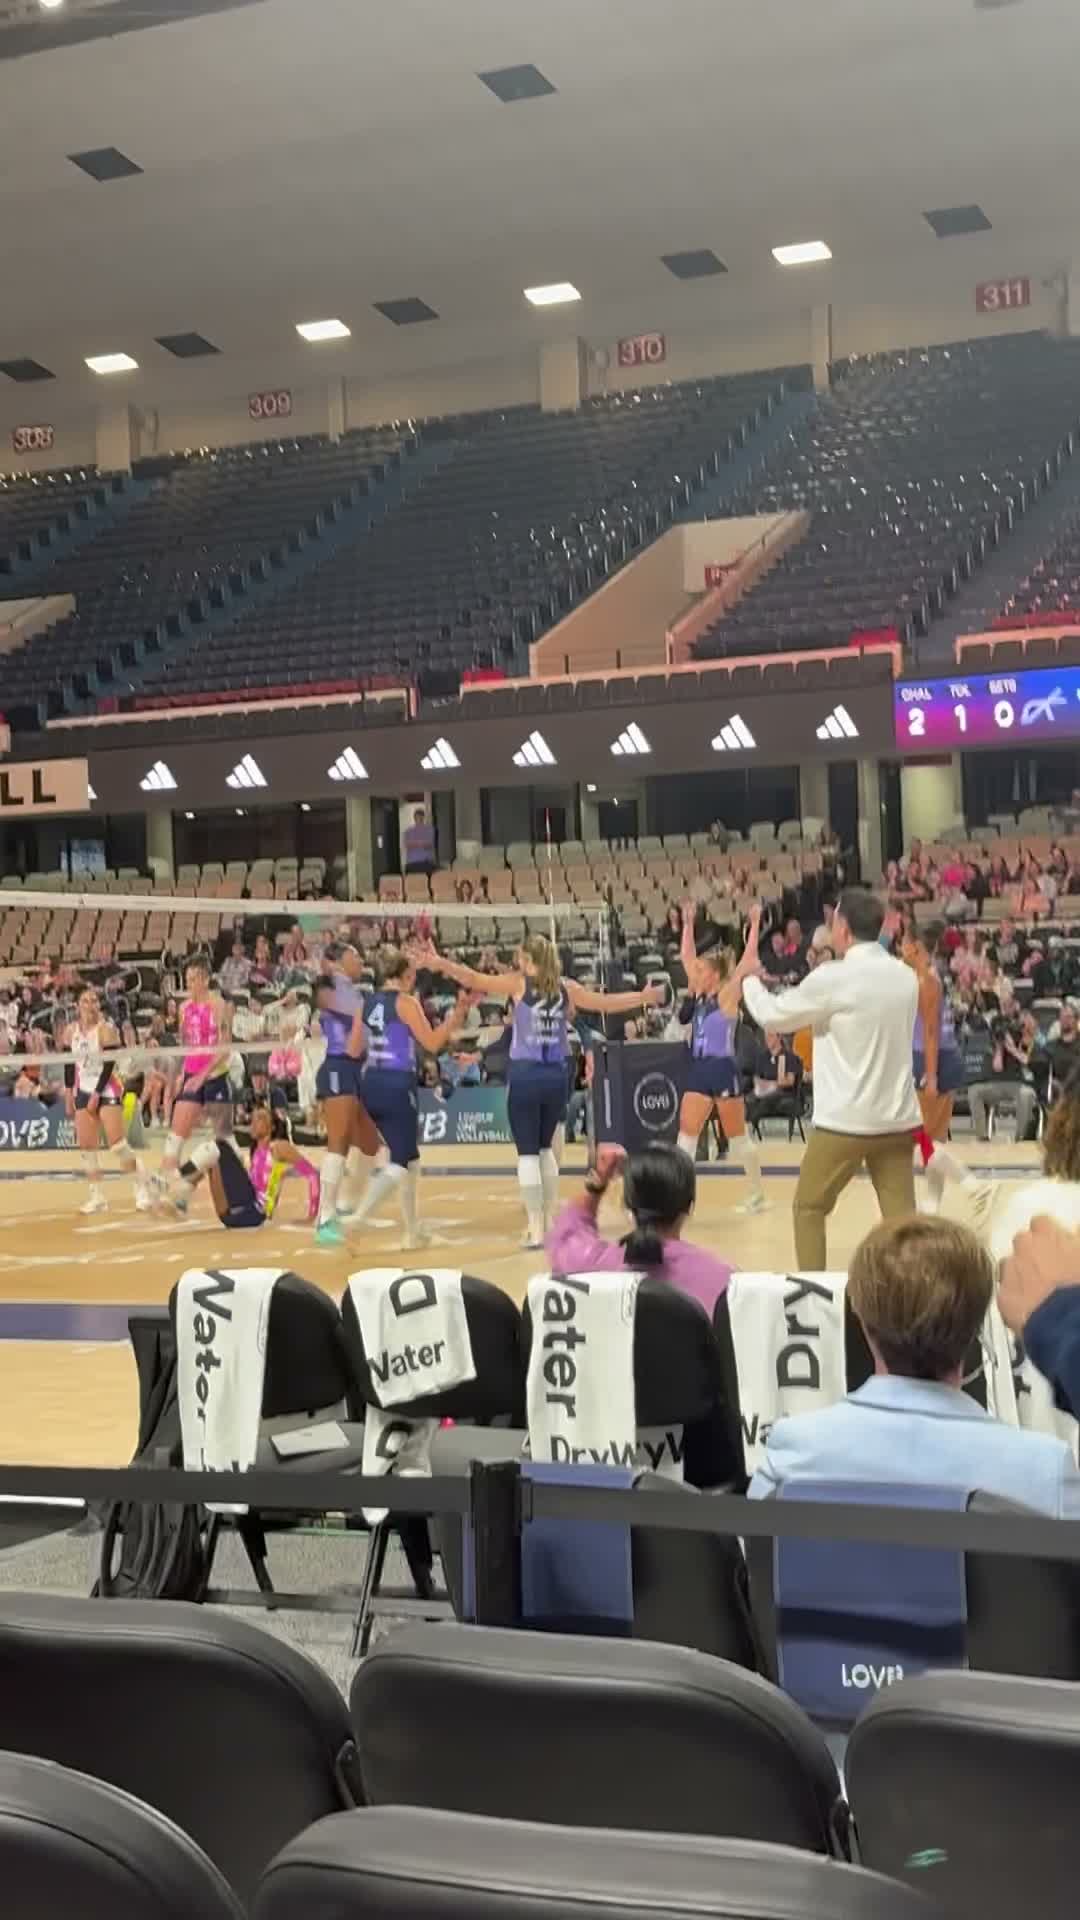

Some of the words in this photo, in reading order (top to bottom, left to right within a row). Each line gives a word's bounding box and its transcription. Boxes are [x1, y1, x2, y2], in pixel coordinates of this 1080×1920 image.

[983, 282, 1024, 309] 311
[620, 335, 663, 364] 310
[250, 393, 290, 418] 309
[908, 707, 926, 736] 2
[954, 703, 967, 733] 1
[994, 699, 1014, 729] 0
[367, 1002, 385, 1031] 4
[775, 1274, 834, 1389] Dry
